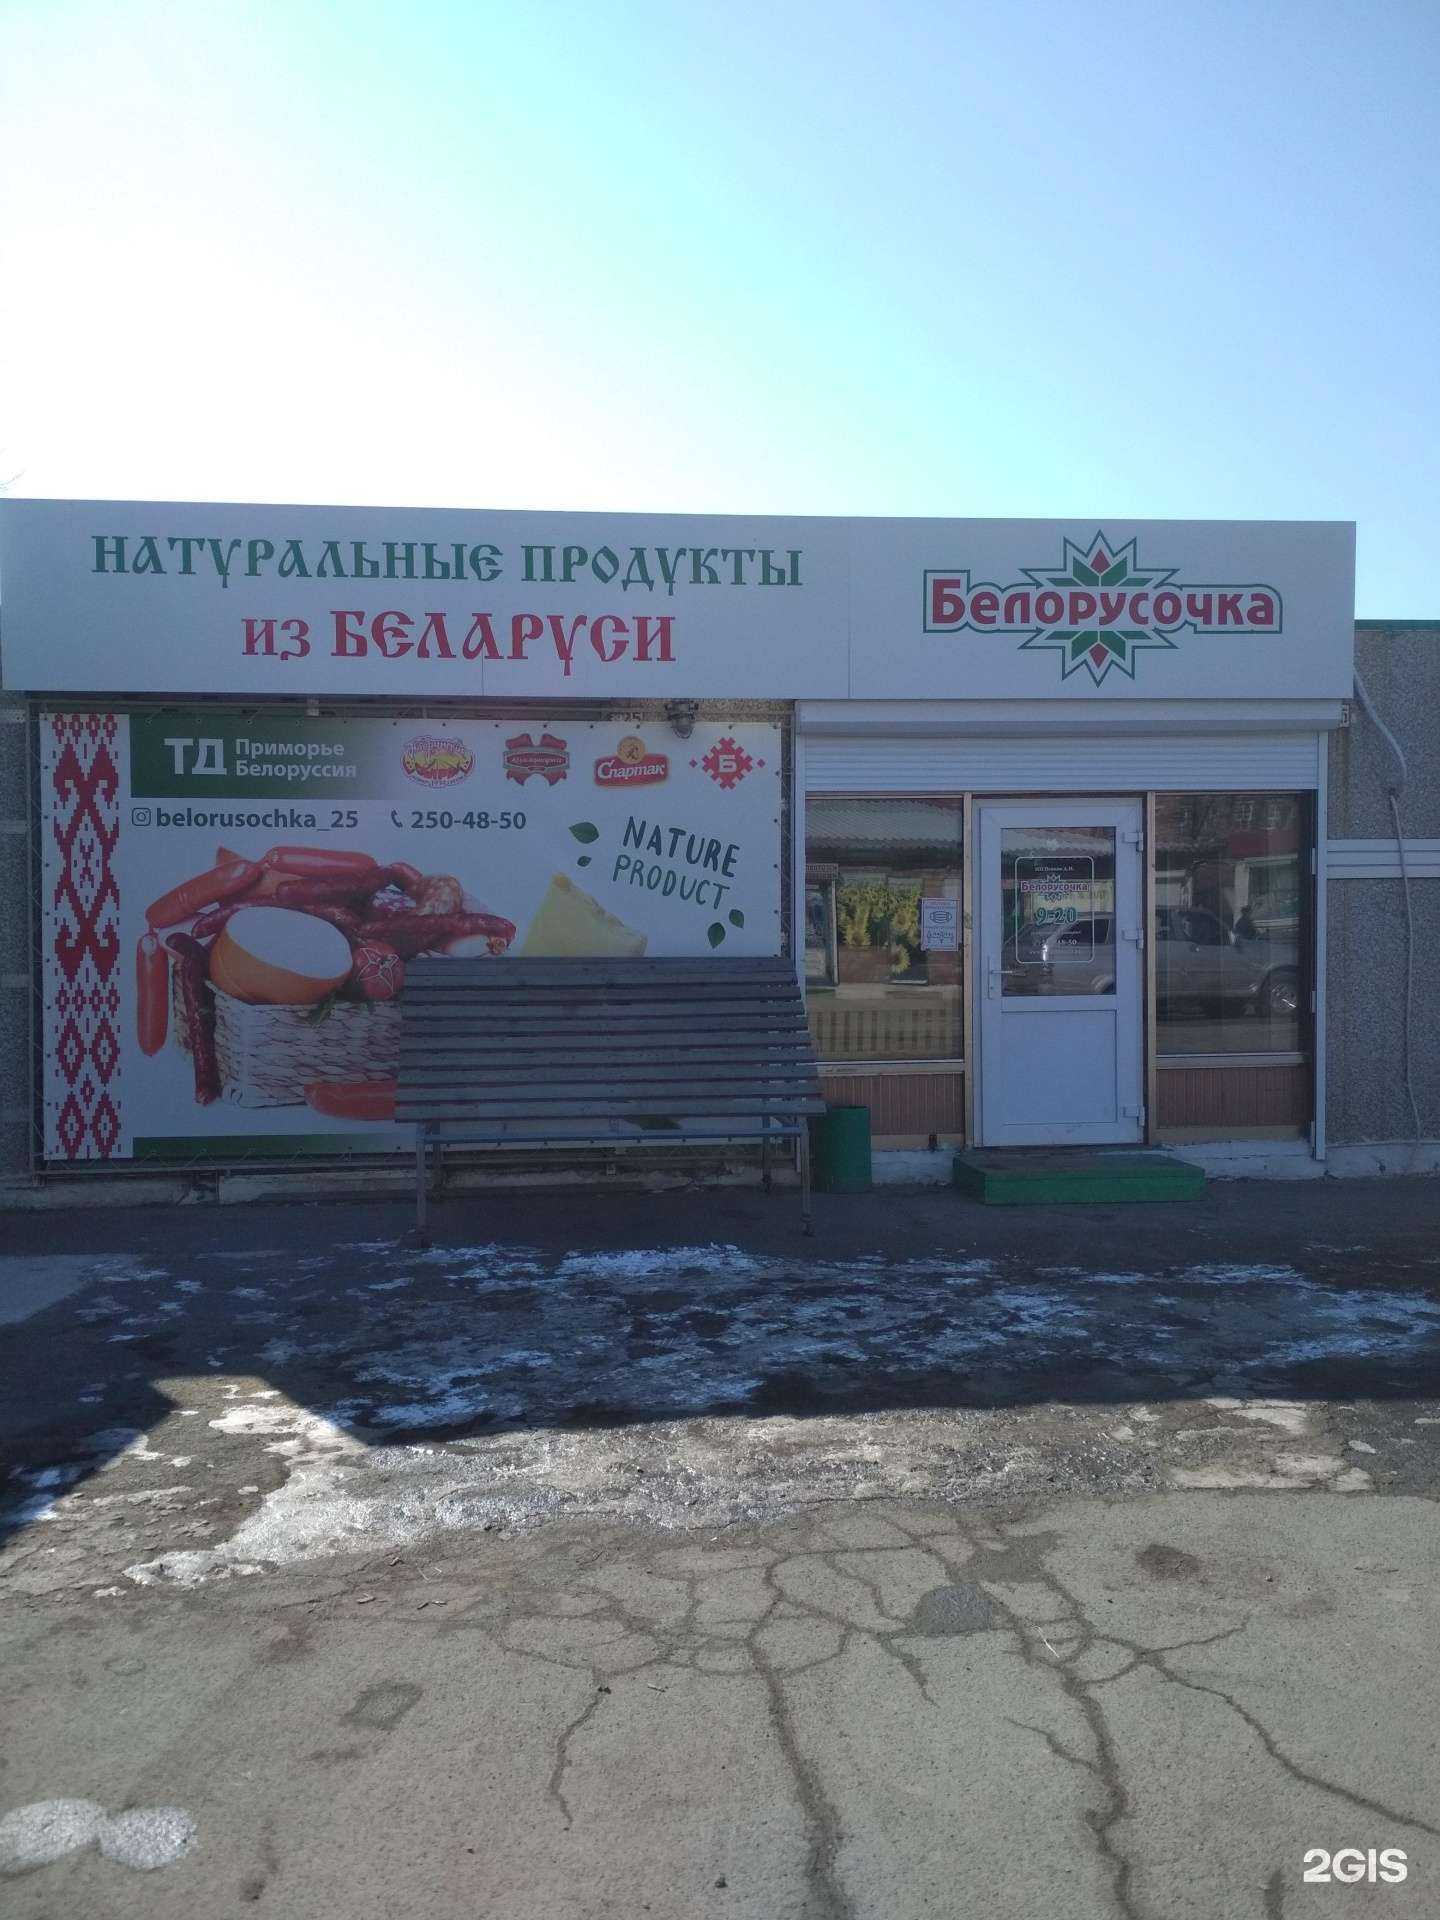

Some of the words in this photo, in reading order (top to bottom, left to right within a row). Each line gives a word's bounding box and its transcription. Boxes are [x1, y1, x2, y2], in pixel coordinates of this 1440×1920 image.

[91, 535, 503, 588] НАТУРАЛЬНЫЕ
[520, 545, 803, 596] ПРОДУКТЫ
[932, 579, 1274, 625] Белорусочка
[329, 610, 676, 676] БЕЛАРУСИ
[164, 738, 227, 775] ТД
[235, 738, 345, 758] Приморье
[235, 760, 357, 780] Белоруссия
[156, 807, 359, 831] belorusochka_25
[411, 810, 527, 830] 250-48-50
[622, 816, 741, 878] NATURE
[612, 854, 731, 910] PRODUCT
[1021, 881, 1088, 892] Белорусочка
[1035, 907, 1078, 927] 9-20
